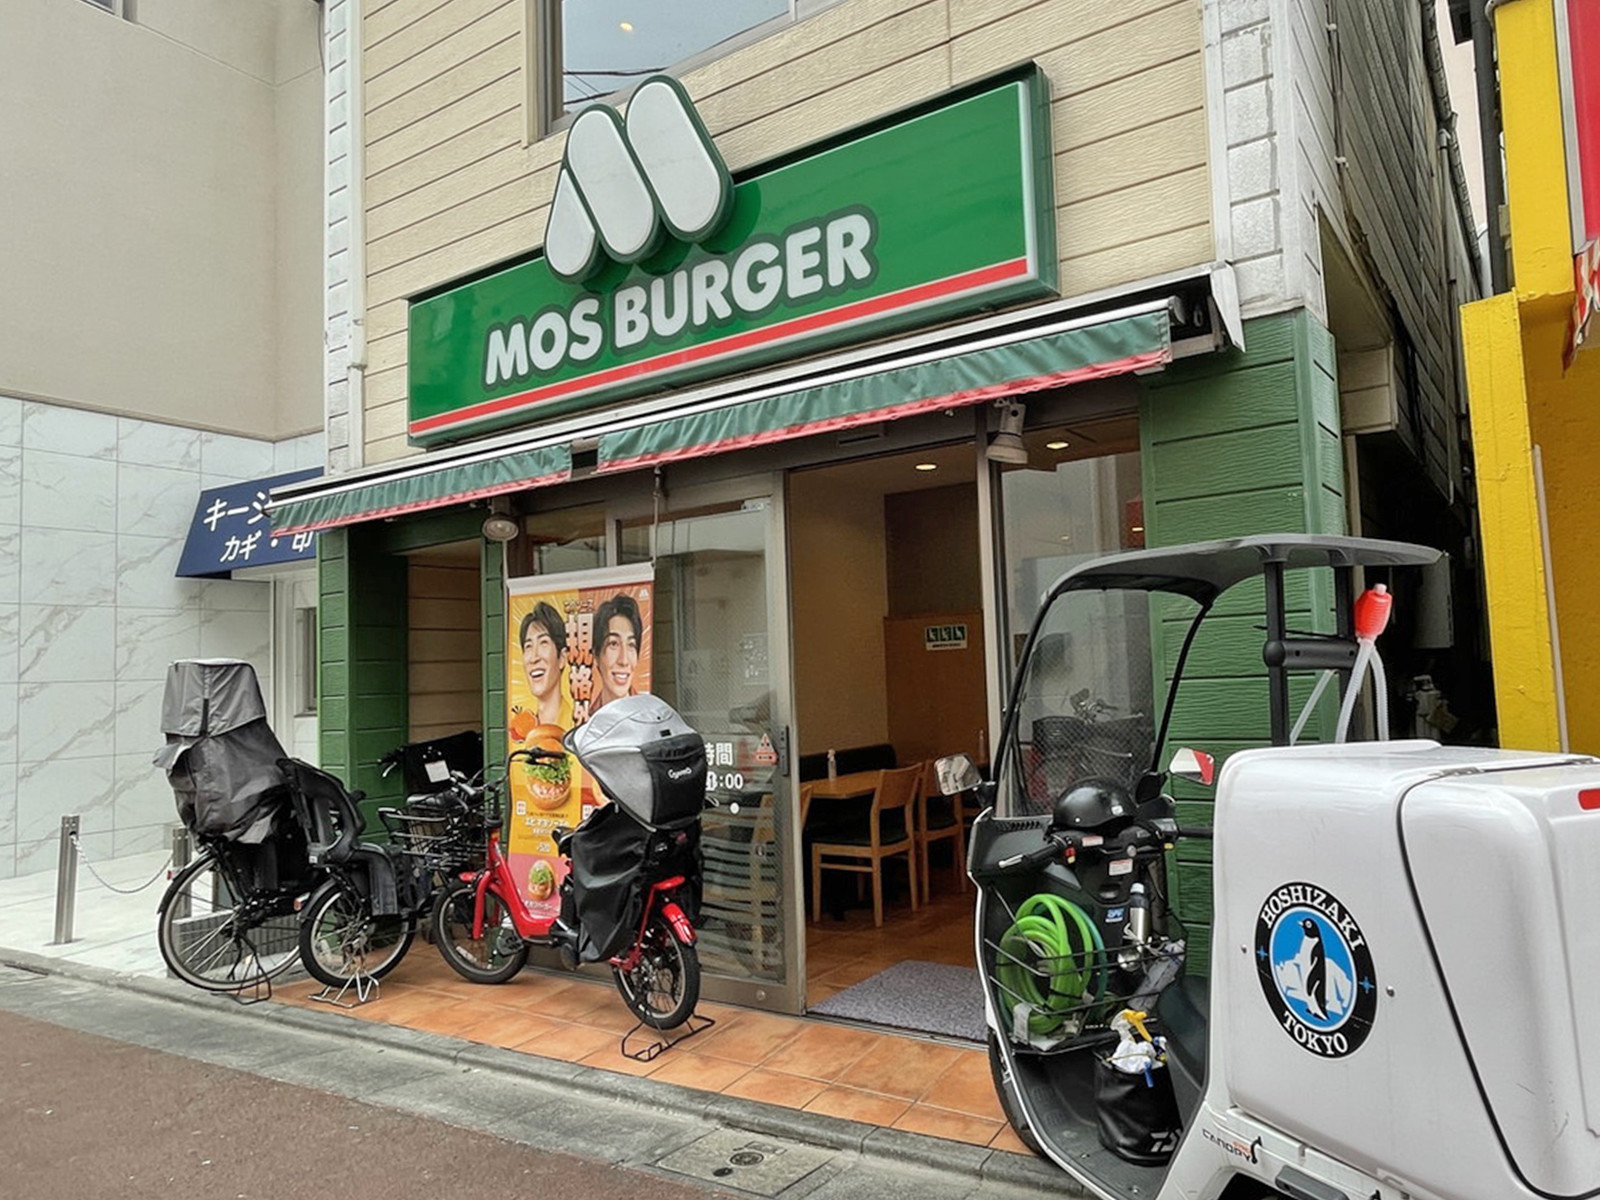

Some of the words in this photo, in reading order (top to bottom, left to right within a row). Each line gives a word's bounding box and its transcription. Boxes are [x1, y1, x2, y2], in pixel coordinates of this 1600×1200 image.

[484, 299, 602, 385] MOS
[614, 214, 872, 349] BURGER
[1260, 885, 1365, 952] HOSHIZAKI
[1283, 1012, 1348, 1056] TOKYO
